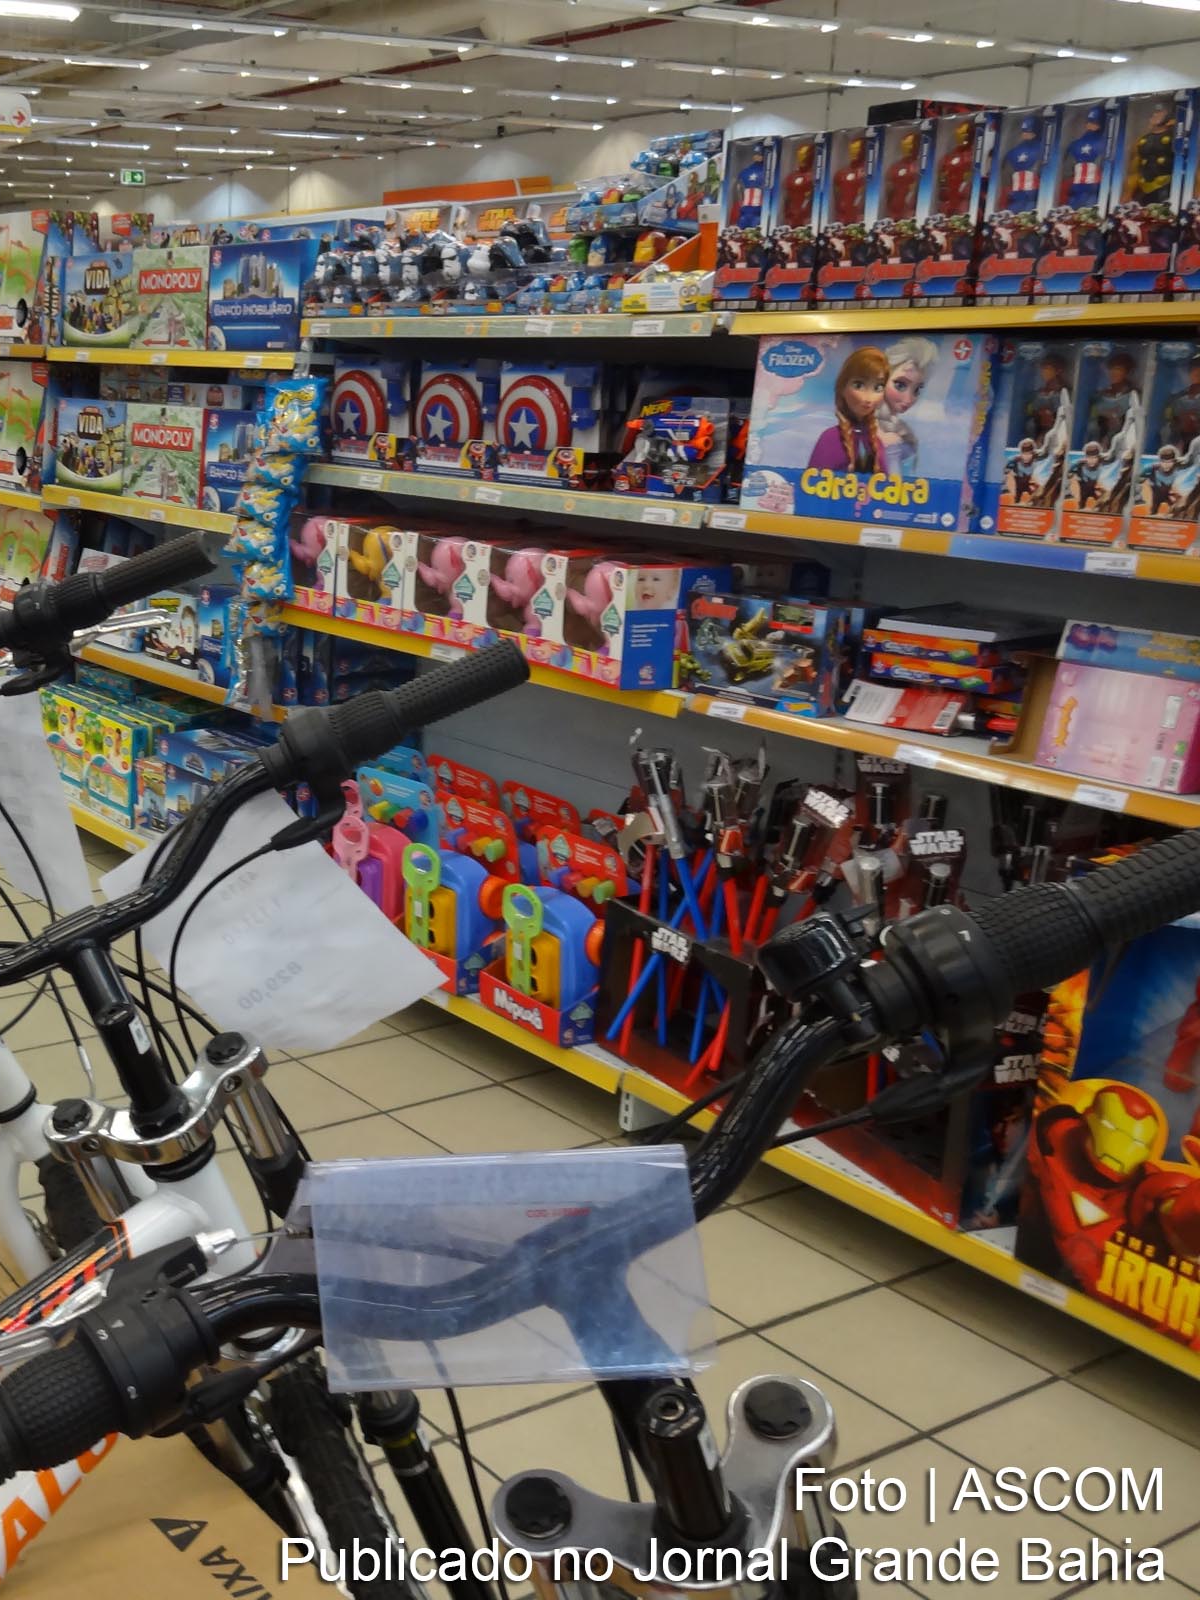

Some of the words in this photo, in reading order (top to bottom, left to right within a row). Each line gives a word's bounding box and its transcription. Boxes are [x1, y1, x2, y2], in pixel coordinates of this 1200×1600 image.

[86, 269, 110, 289] VIDA
[140, 271, 200, 291] MONOPOLY
[768, 353, 815, 367] FROZEN
[78, 415, 104, 434] VIDA
[133, 429, 193, 448] MONOPOLY
[909, 830, 963, 844] STAR
[910, 840, 964, 855] WARS
[1095, 1239, 1200, 1337] IRON
